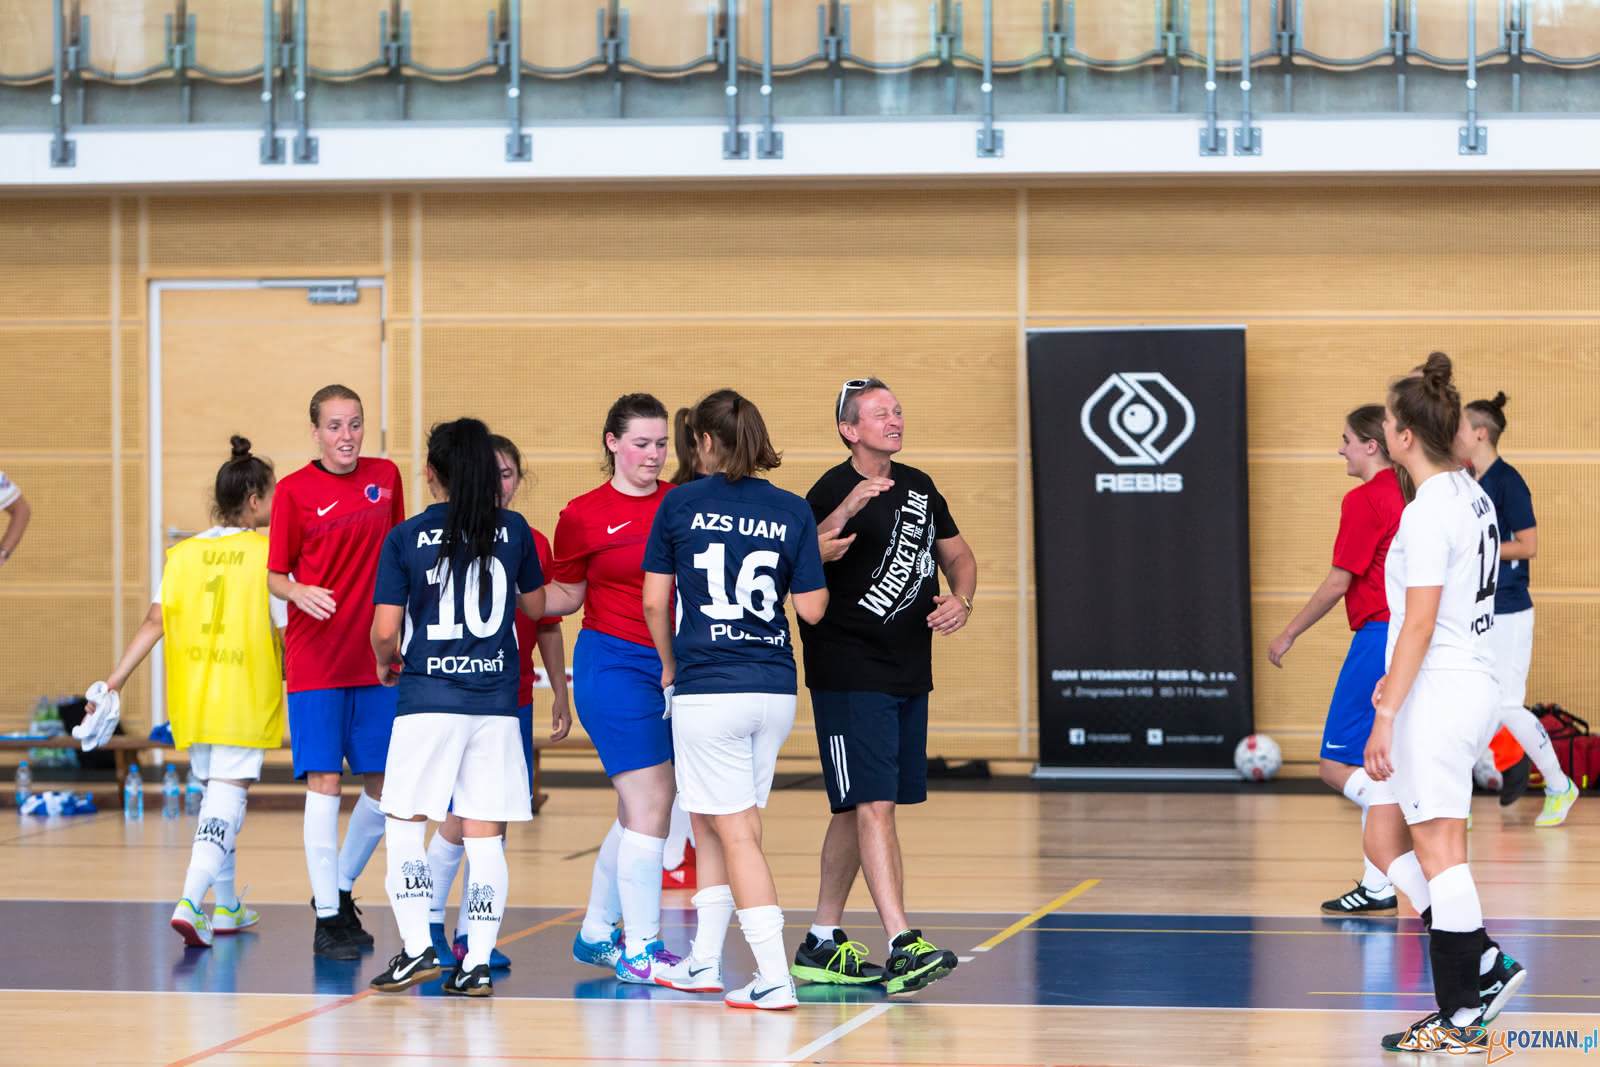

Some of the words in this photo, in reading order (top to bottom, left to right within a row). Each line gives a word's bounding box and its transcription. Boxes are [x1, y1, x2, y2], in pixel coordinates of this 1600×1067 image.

[1095, 473, 1183, 492] REBIS
[691, 513, 733, 532] AZS
[738, 518, 787, 542] UAM
[902, 521, 916, 537] IN
[913, 525, 924, 540] THE
[417, 529, 452, 548] AZ
[202, 551, 245, 566] UAM
[1475, 523, 1498, 604] 12
[693, 543, 780, 623] 16
[201, 575, 225, 634] 1
[426, 555, 507, 640] 10
[1052, 670, 1078, 681] DOM
[1157, 670, 1189, 681] REBIS
